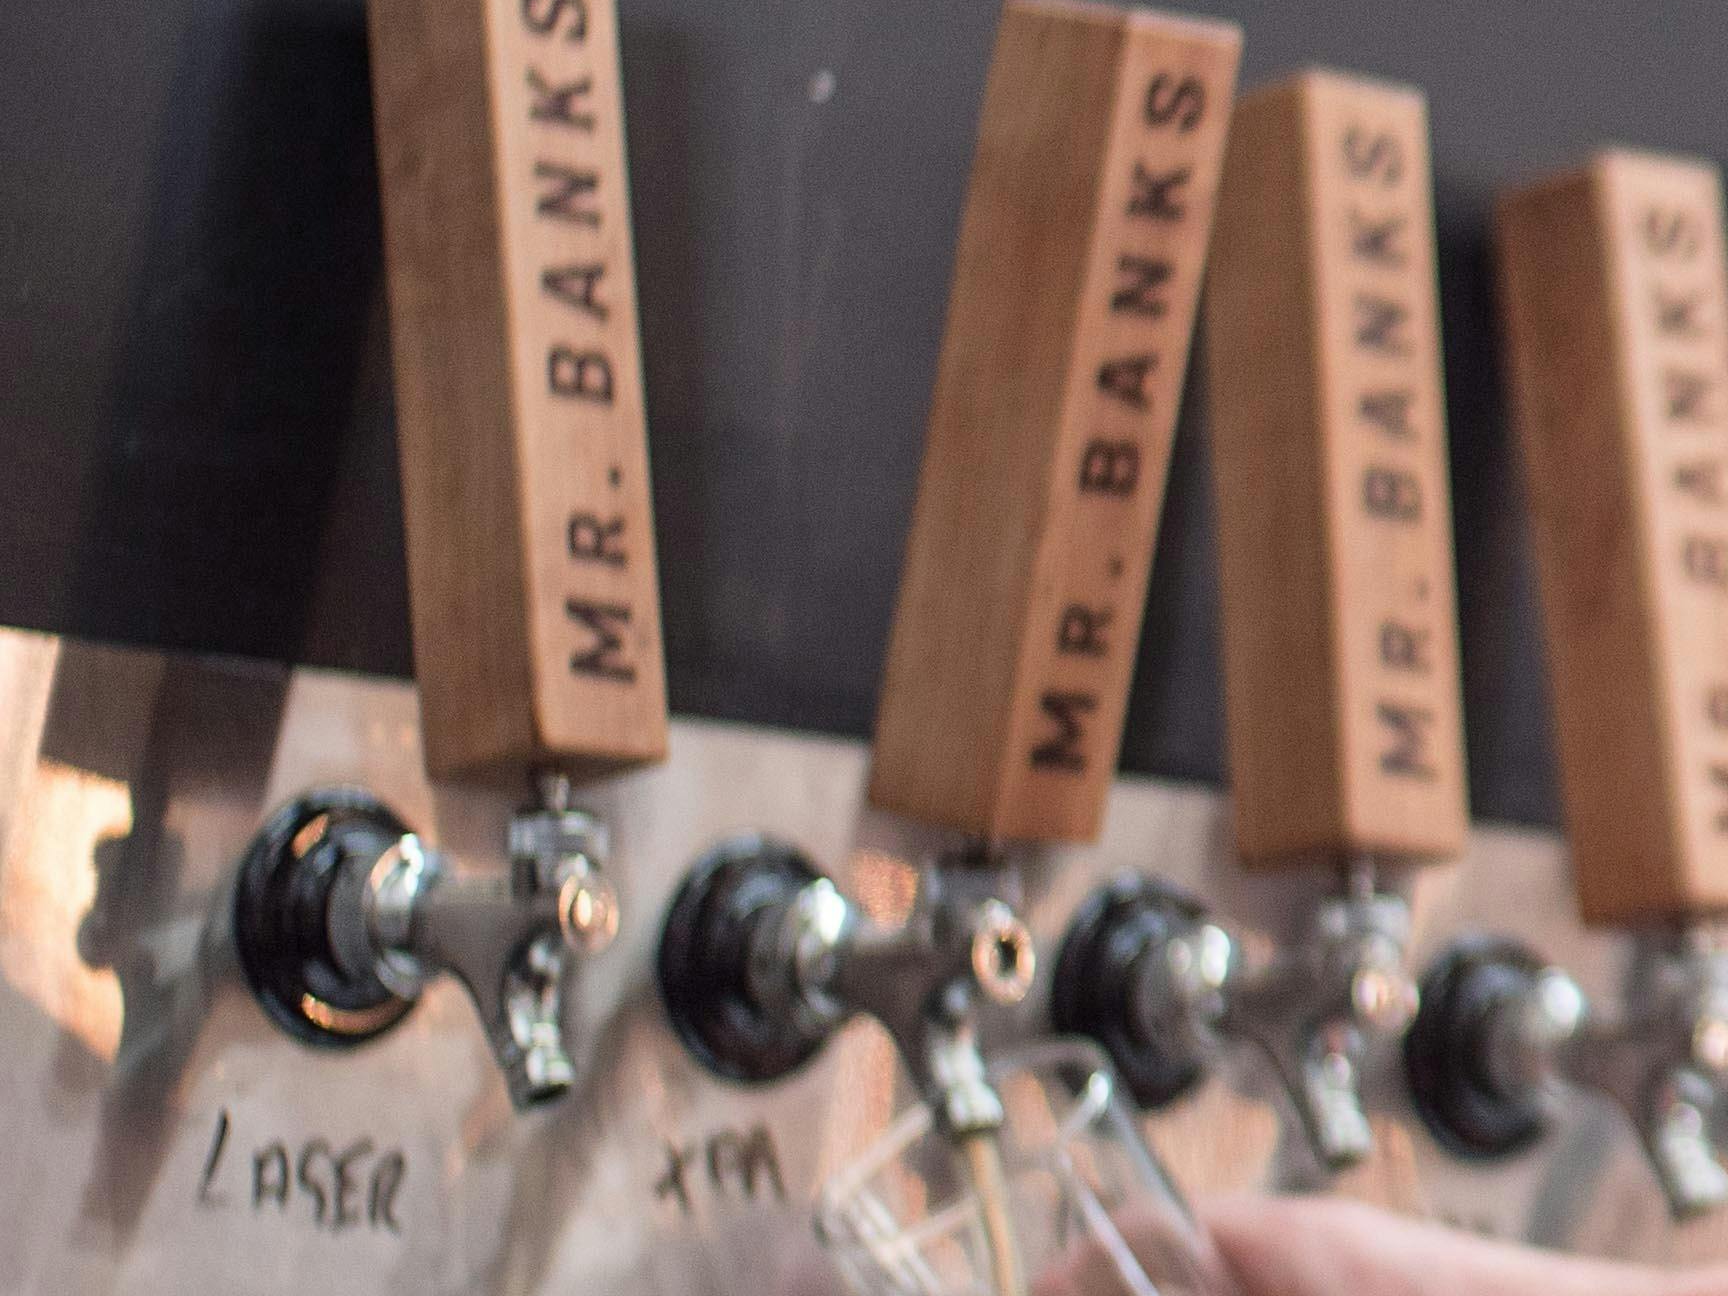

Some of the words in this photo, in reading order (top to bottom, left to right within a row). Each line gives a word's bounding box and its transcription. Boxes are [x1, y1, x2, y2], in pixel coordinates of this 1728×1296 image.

[1029, 557, 1124, 776] MR.
[1080, 73, 1205, 499] BANKS
[1342, 124, 1422, 525] BANKS
[564, 467, 636, 684] MR.
[1379, 584, 1435, 781] MR.
[197, 1107, 408, 1236] LASER
